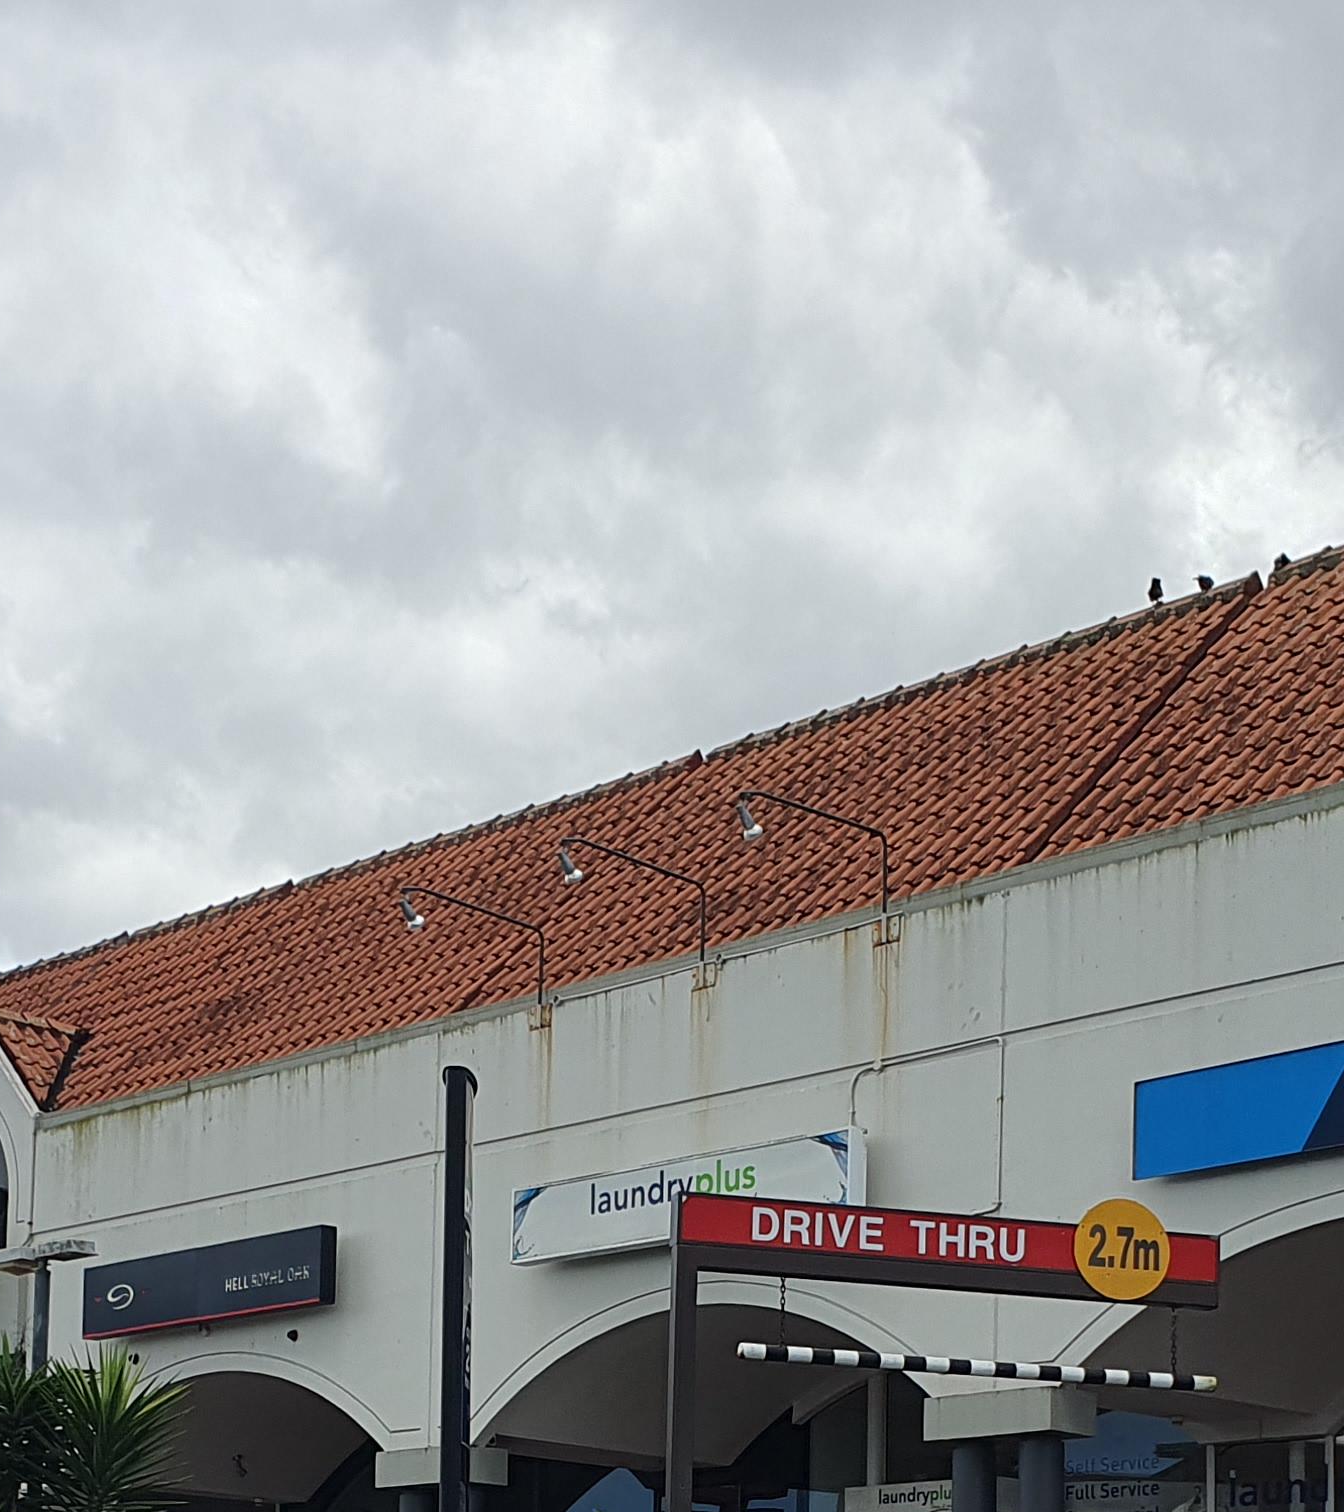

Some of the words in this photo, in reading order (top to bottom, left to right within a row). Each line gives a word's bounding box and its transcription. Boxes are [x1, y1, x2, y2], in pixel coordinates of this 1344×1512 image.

[751, 1206, 885, 1252] DRIVE
[909, 1219, 1026, 1263] THRU
[1087, 1223, 1160, 1272] 2.7m
[225, 1275, 249, 1293] HELL
[1100, 1456, 1159, 1472] Service
[879, 1485, 952, 1506] laundryplu
[1065, 1483, 1095, 1500] Full
[1100, 1480, 1160, 1498] Service
